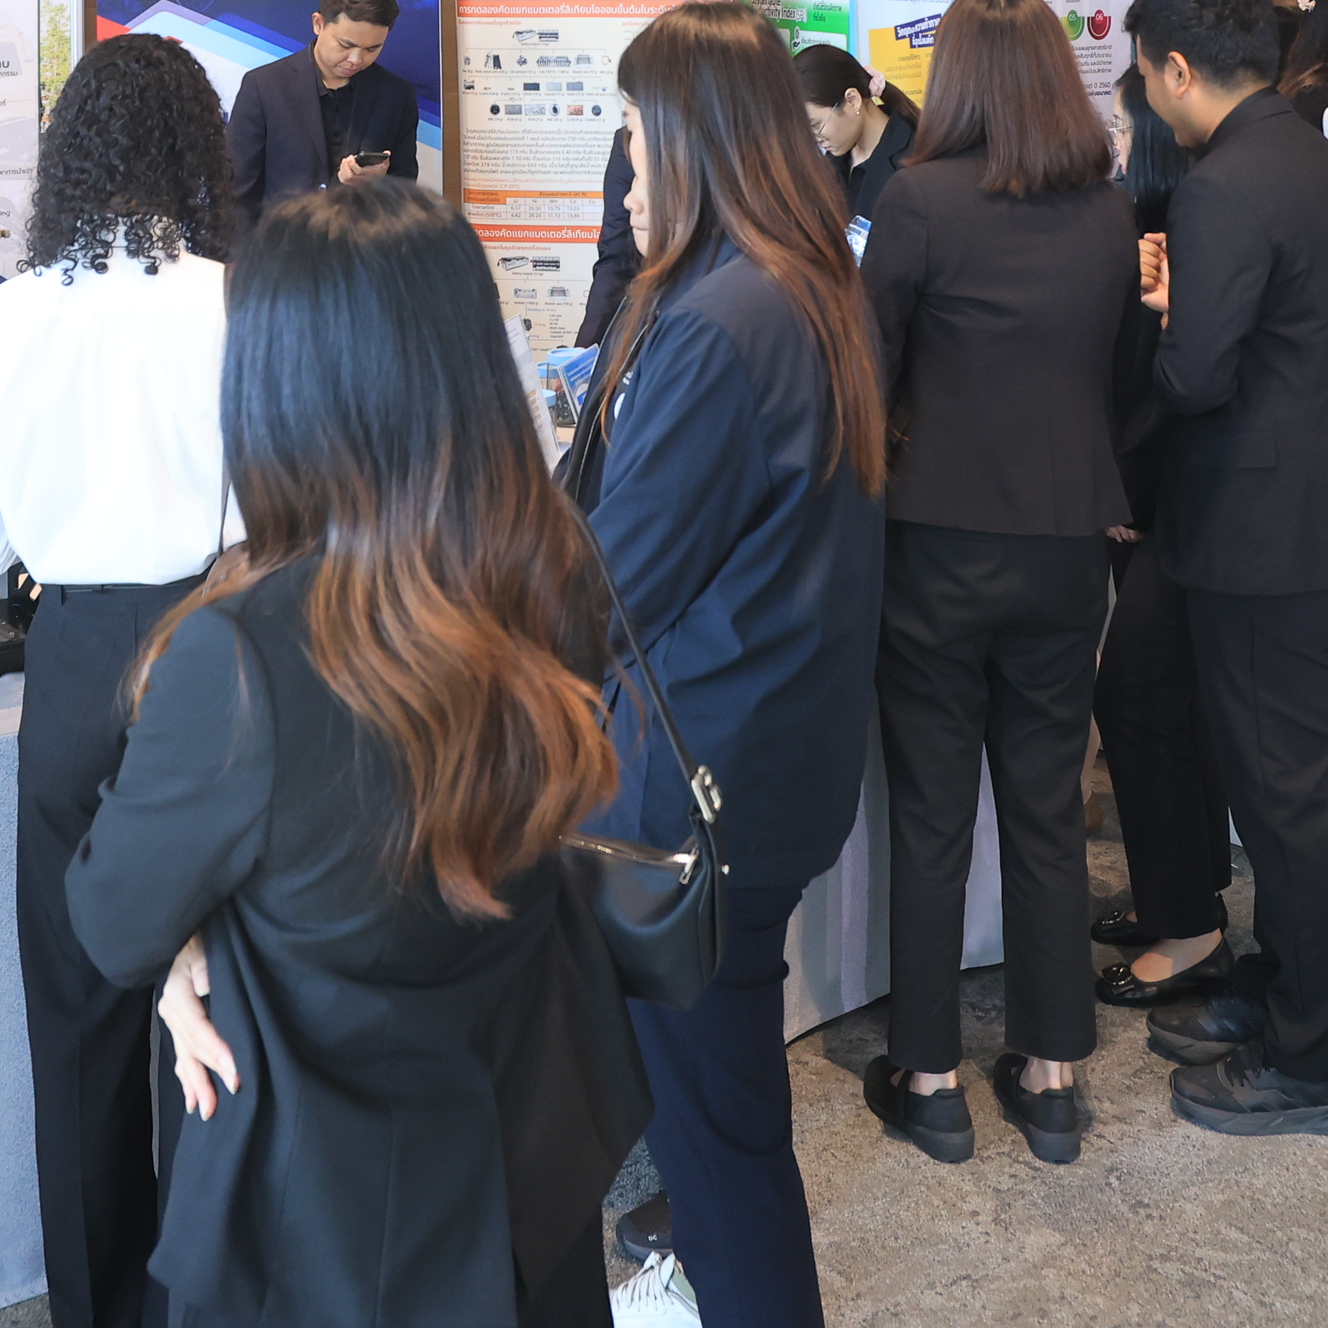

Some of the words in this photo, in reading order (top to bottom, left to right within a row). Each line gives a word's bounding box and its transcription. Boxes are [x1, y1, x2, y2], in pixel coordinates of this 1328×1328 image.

[781, 7, 796, 19] Index
[1068, 13, 1077, 21] 05
[1095, 13, 1104, 21] 06
